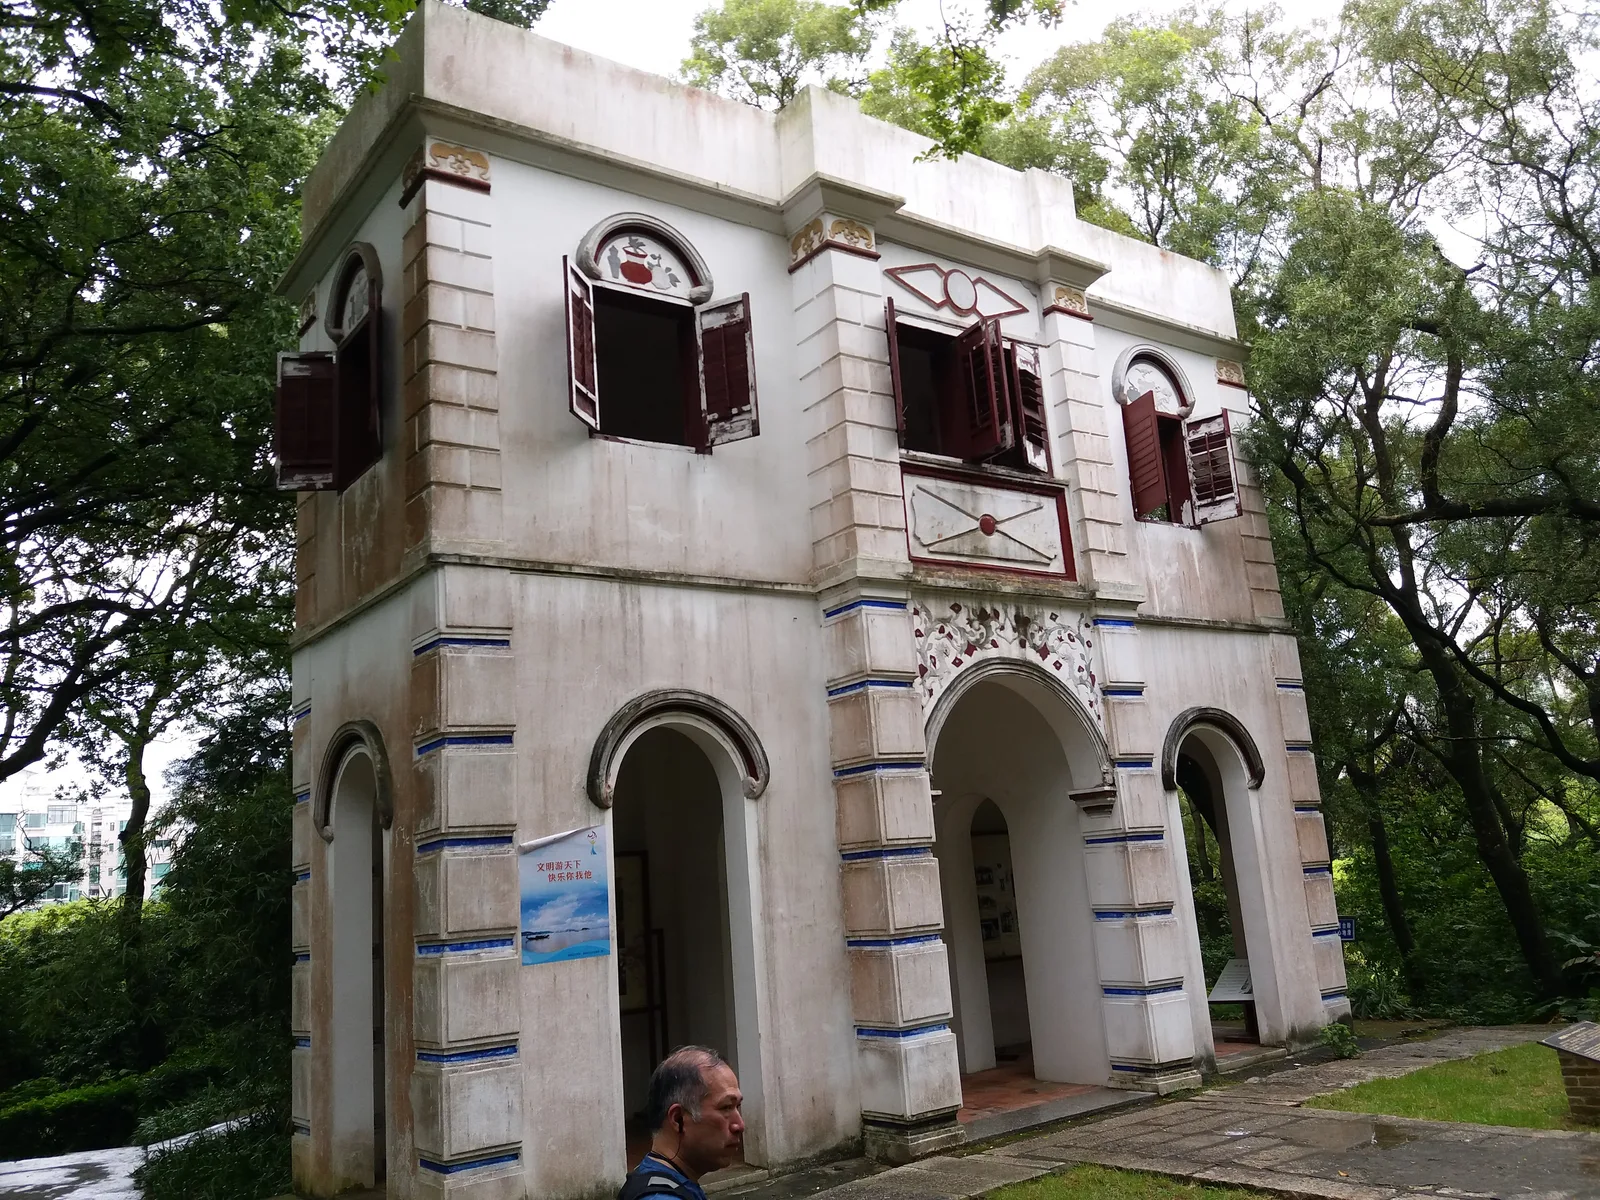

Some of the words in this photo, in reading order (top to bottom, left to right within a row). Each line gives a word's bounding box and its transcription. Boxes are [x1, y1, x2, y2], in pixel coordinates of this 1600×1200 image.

[537, 860, 581, 872] 文明游天下
[548, 870, 592, 882] 快乐你我他
